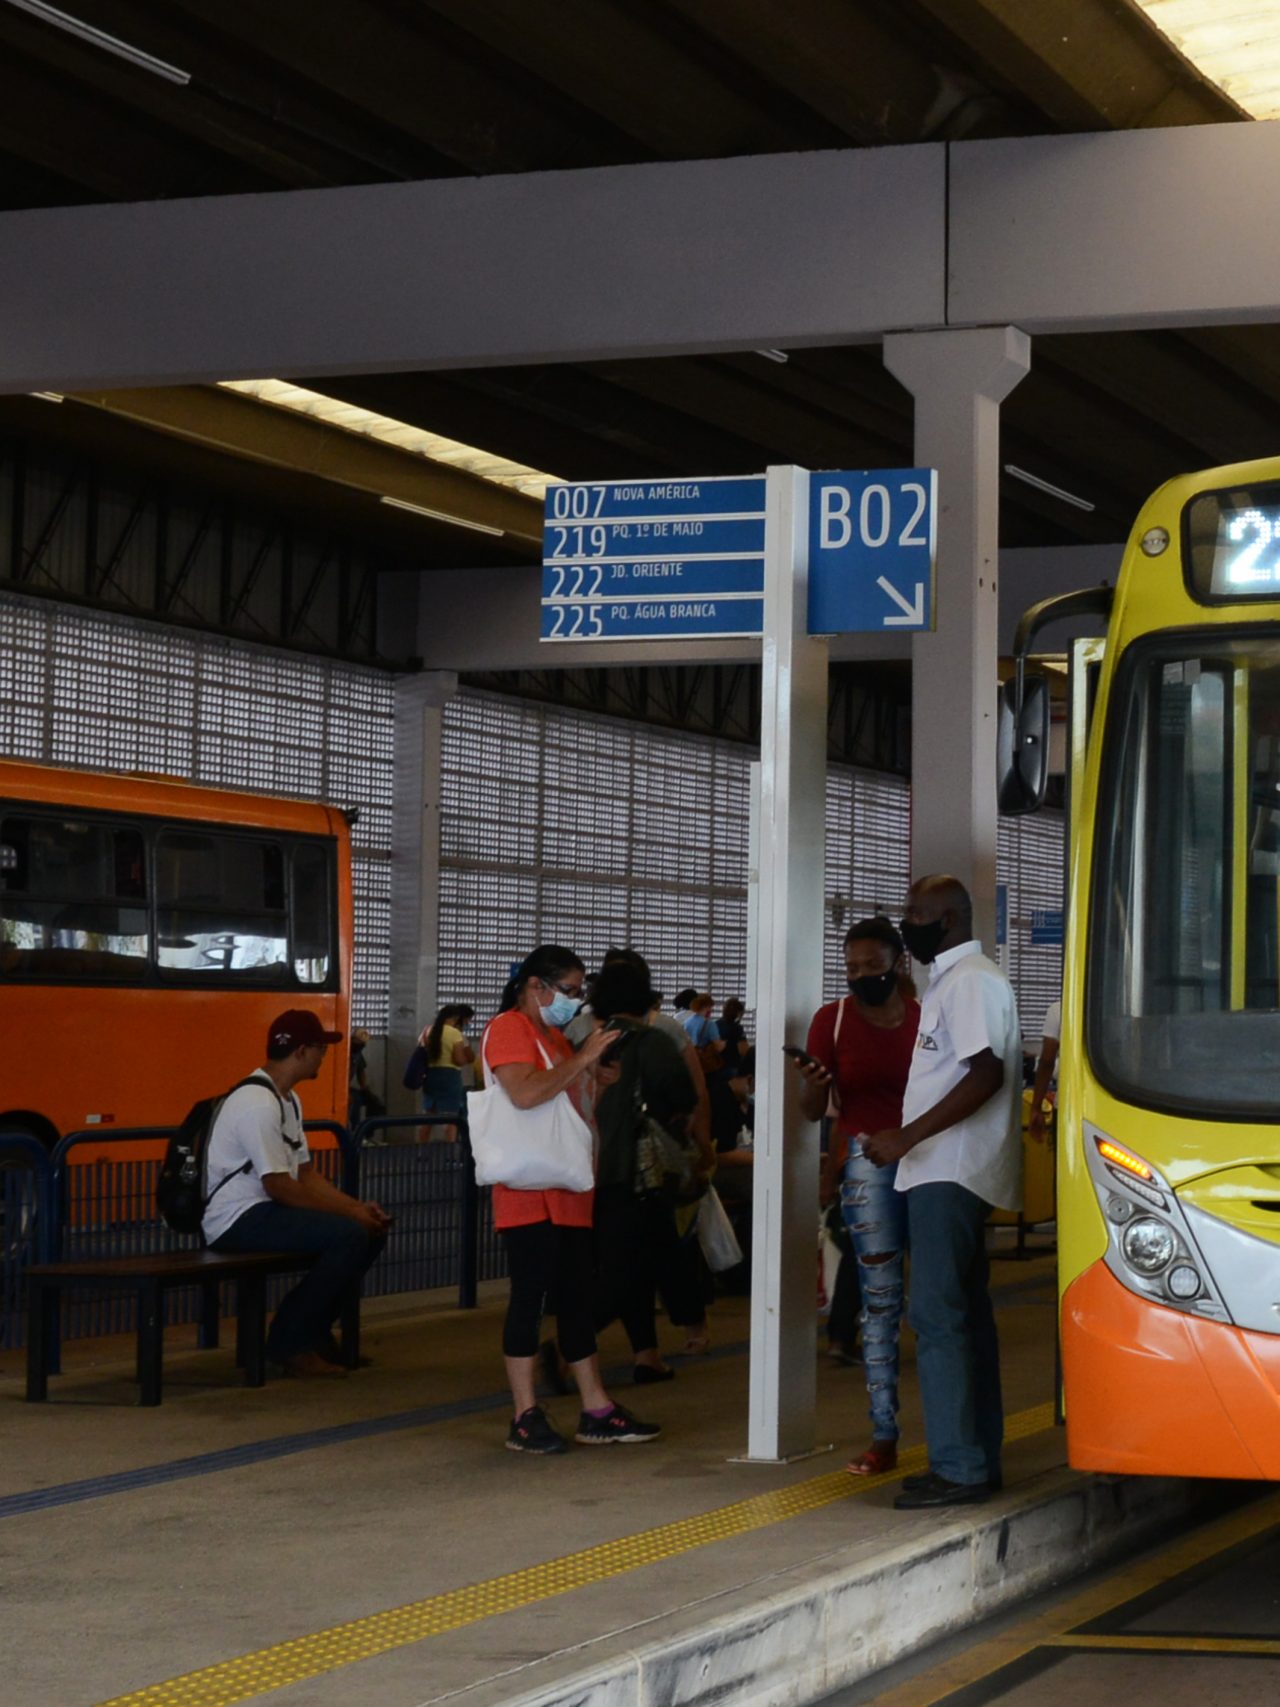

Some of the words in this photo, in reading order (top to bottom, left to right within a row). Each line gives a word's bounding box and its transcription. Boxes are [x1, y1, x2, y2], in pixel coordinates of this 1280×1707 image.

[553, 486, 607, 519] 007
[613, 488, 645, 500] NOVA
[648, 485, 700, 499] AMÉRICA
[820, 483, 926, 549] B02
[552, 526, 607, 558] 219
[612, 524, 632, 538] PQ.
[653, 523, 669, 537] DE
[673, 522, 704, 536] MAIO
[551, 566, 604, 597] 222
[611, 565, 629, 578] JD.
[632, 563, 683, 577] ORIENTE
[550, 605, 603, 637] 225
[611, 606, 631, 619] PQ.
[634, 604, 666, 618] ÁGUA
[670, 603, 716, 617] BRANCA
